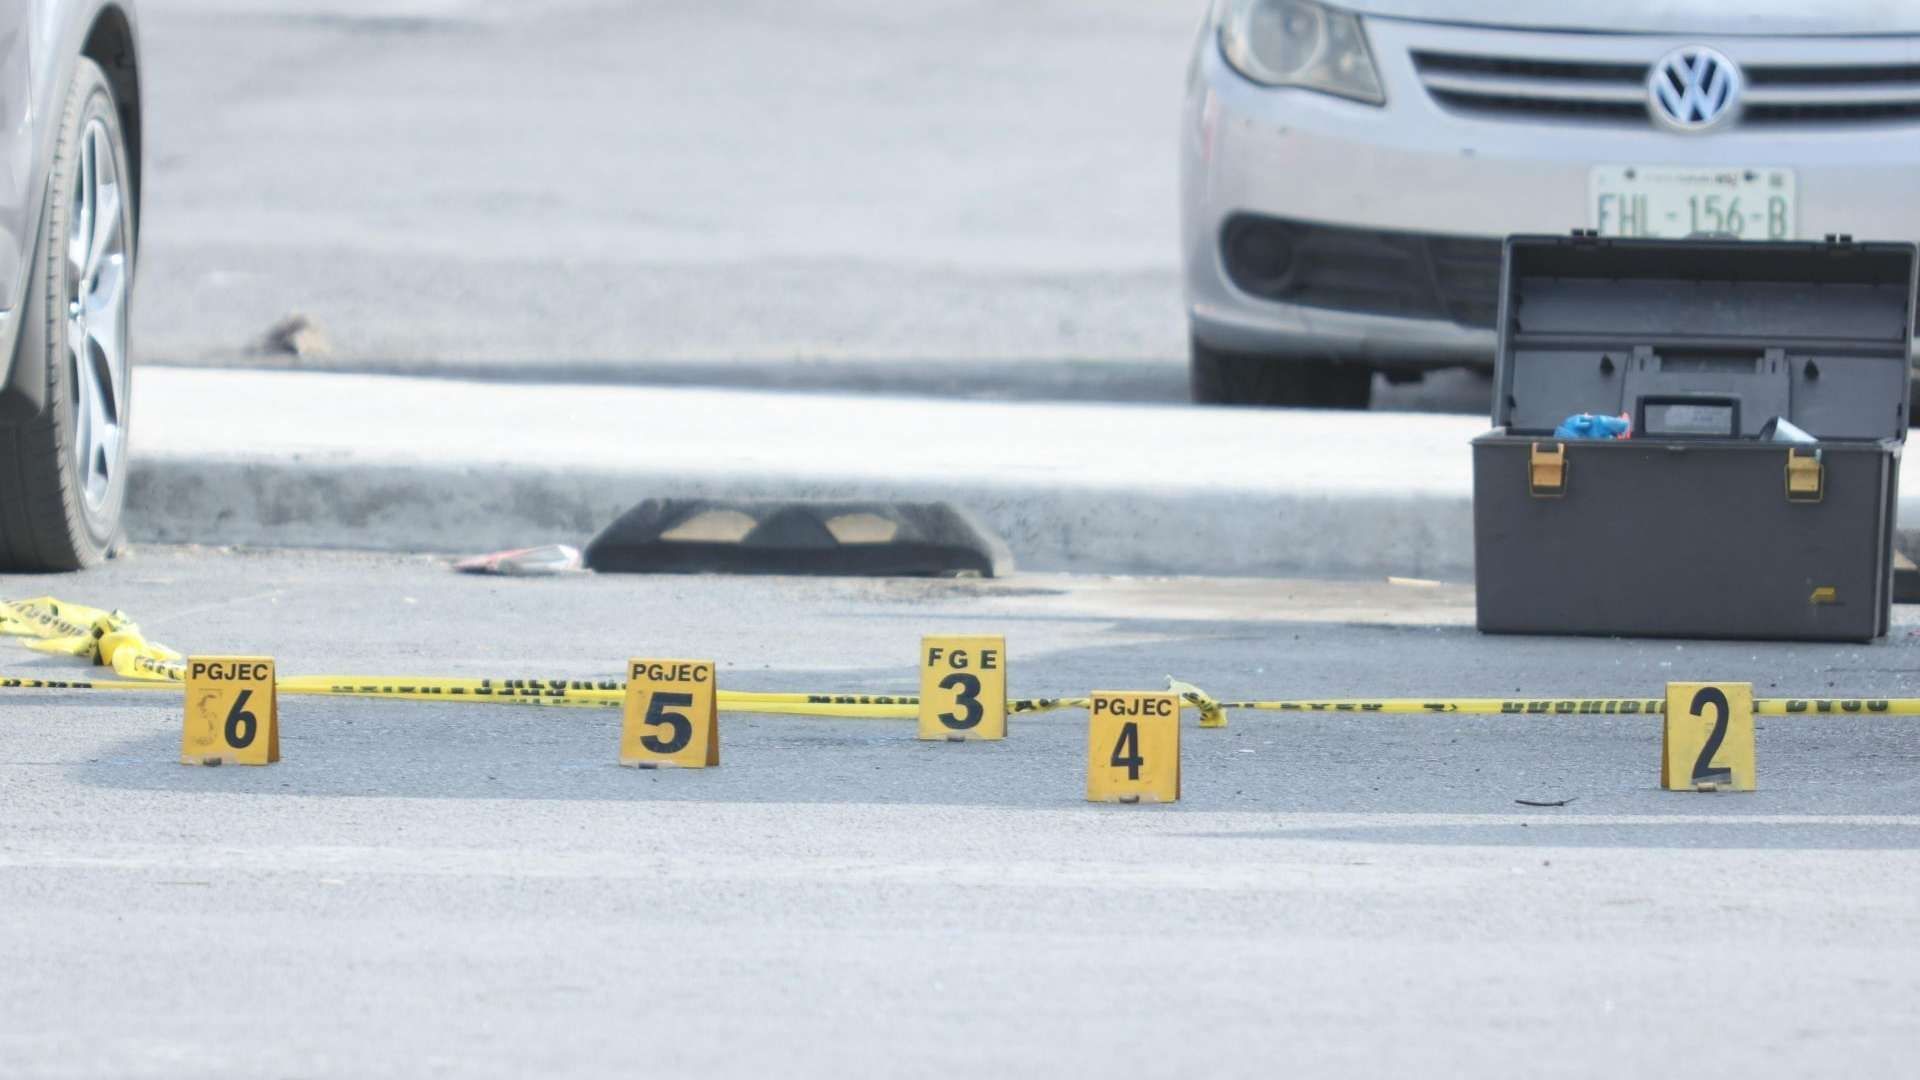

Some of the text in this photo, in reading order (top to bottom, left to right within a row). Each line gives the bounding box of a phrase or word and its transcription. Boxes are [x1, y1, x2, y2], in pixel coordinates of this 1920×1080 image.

[1652, 48, 1736, 126] VW
[192, 663, 268, 680] PGJEC
[632, 664, 708, 682] PGJEC
[640, 691, 693, 754] 5
[937, 673, 984, 730] 3
[1093, 698, 1172, 716] PGJEC
[1110, 721, 1144, 781] 4
[1689, 686, 1732, 785] 2
